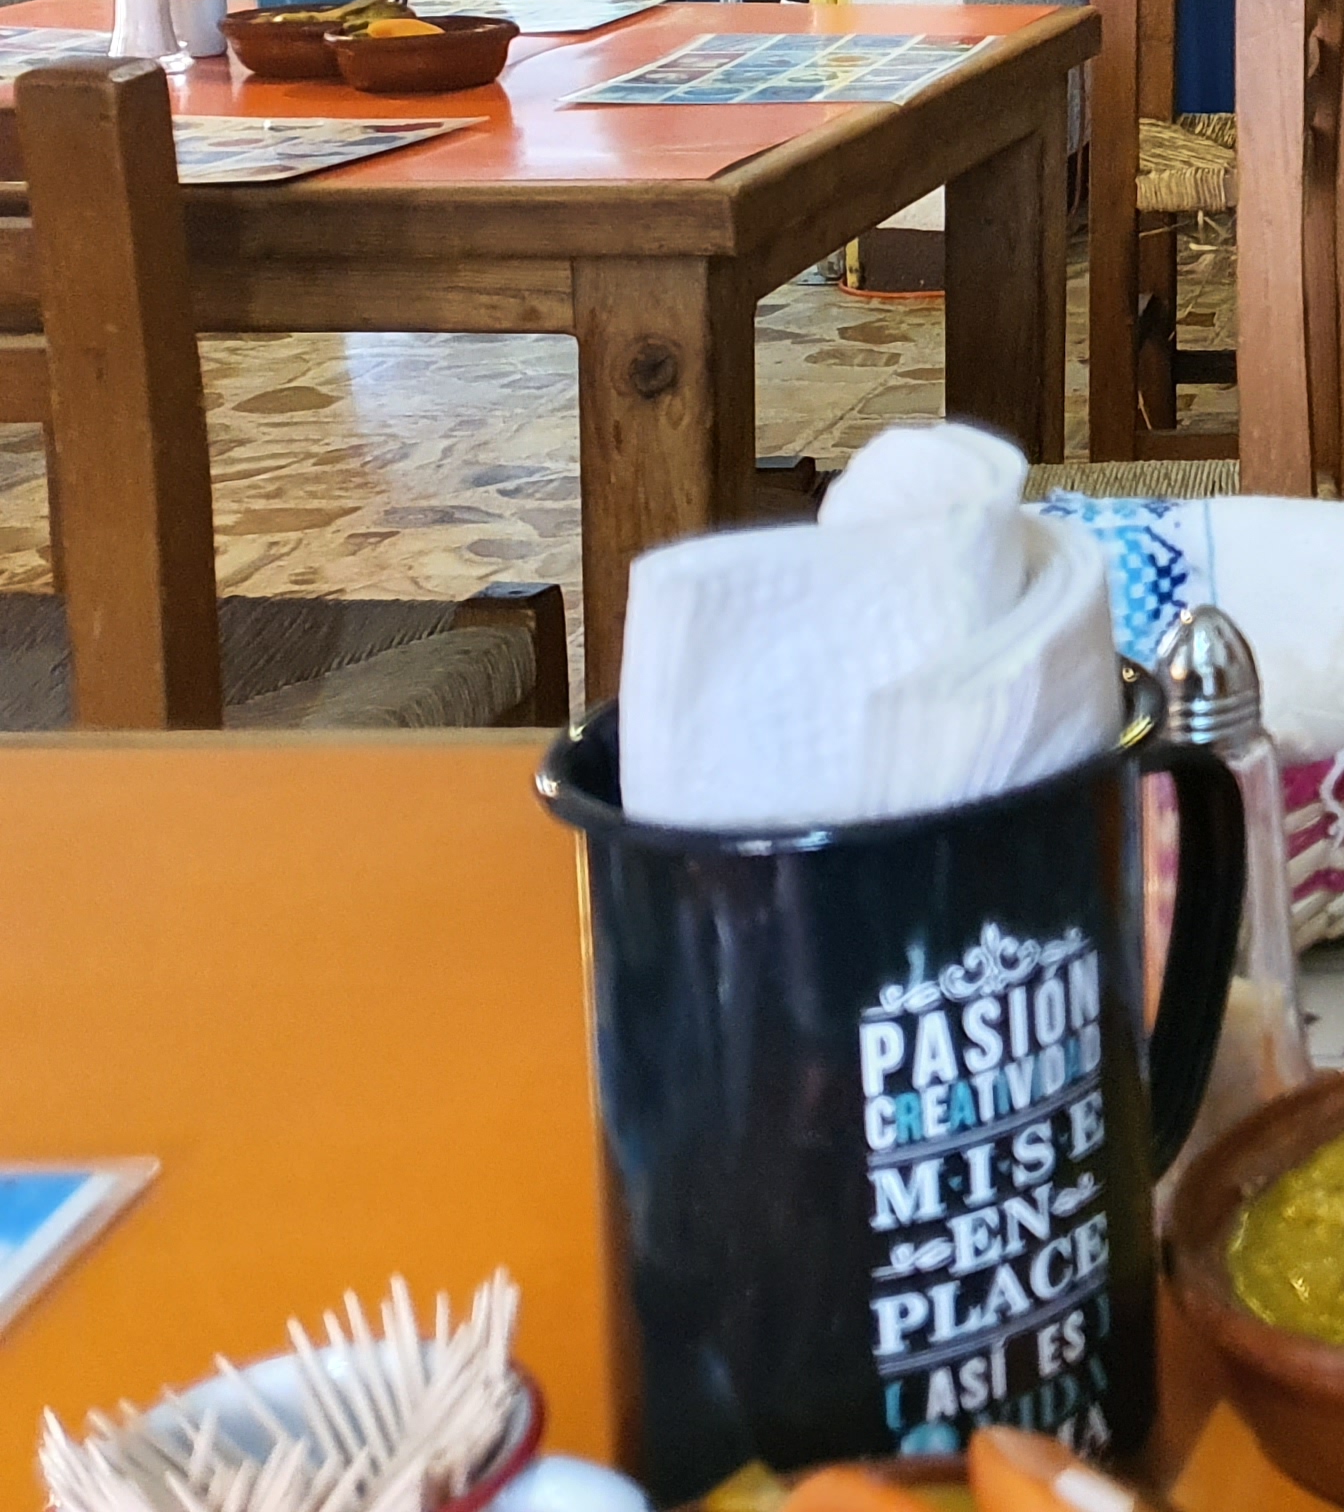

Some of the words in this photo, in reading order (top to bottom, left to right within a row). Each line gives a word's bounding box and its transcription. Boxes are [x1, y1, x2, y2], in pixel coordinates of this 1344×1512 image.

[867, 1090, 1105, 1233] MISE
[946, 1180, 1053, 1277] EN
[868, 1209, 1110, 1356] PLACE
